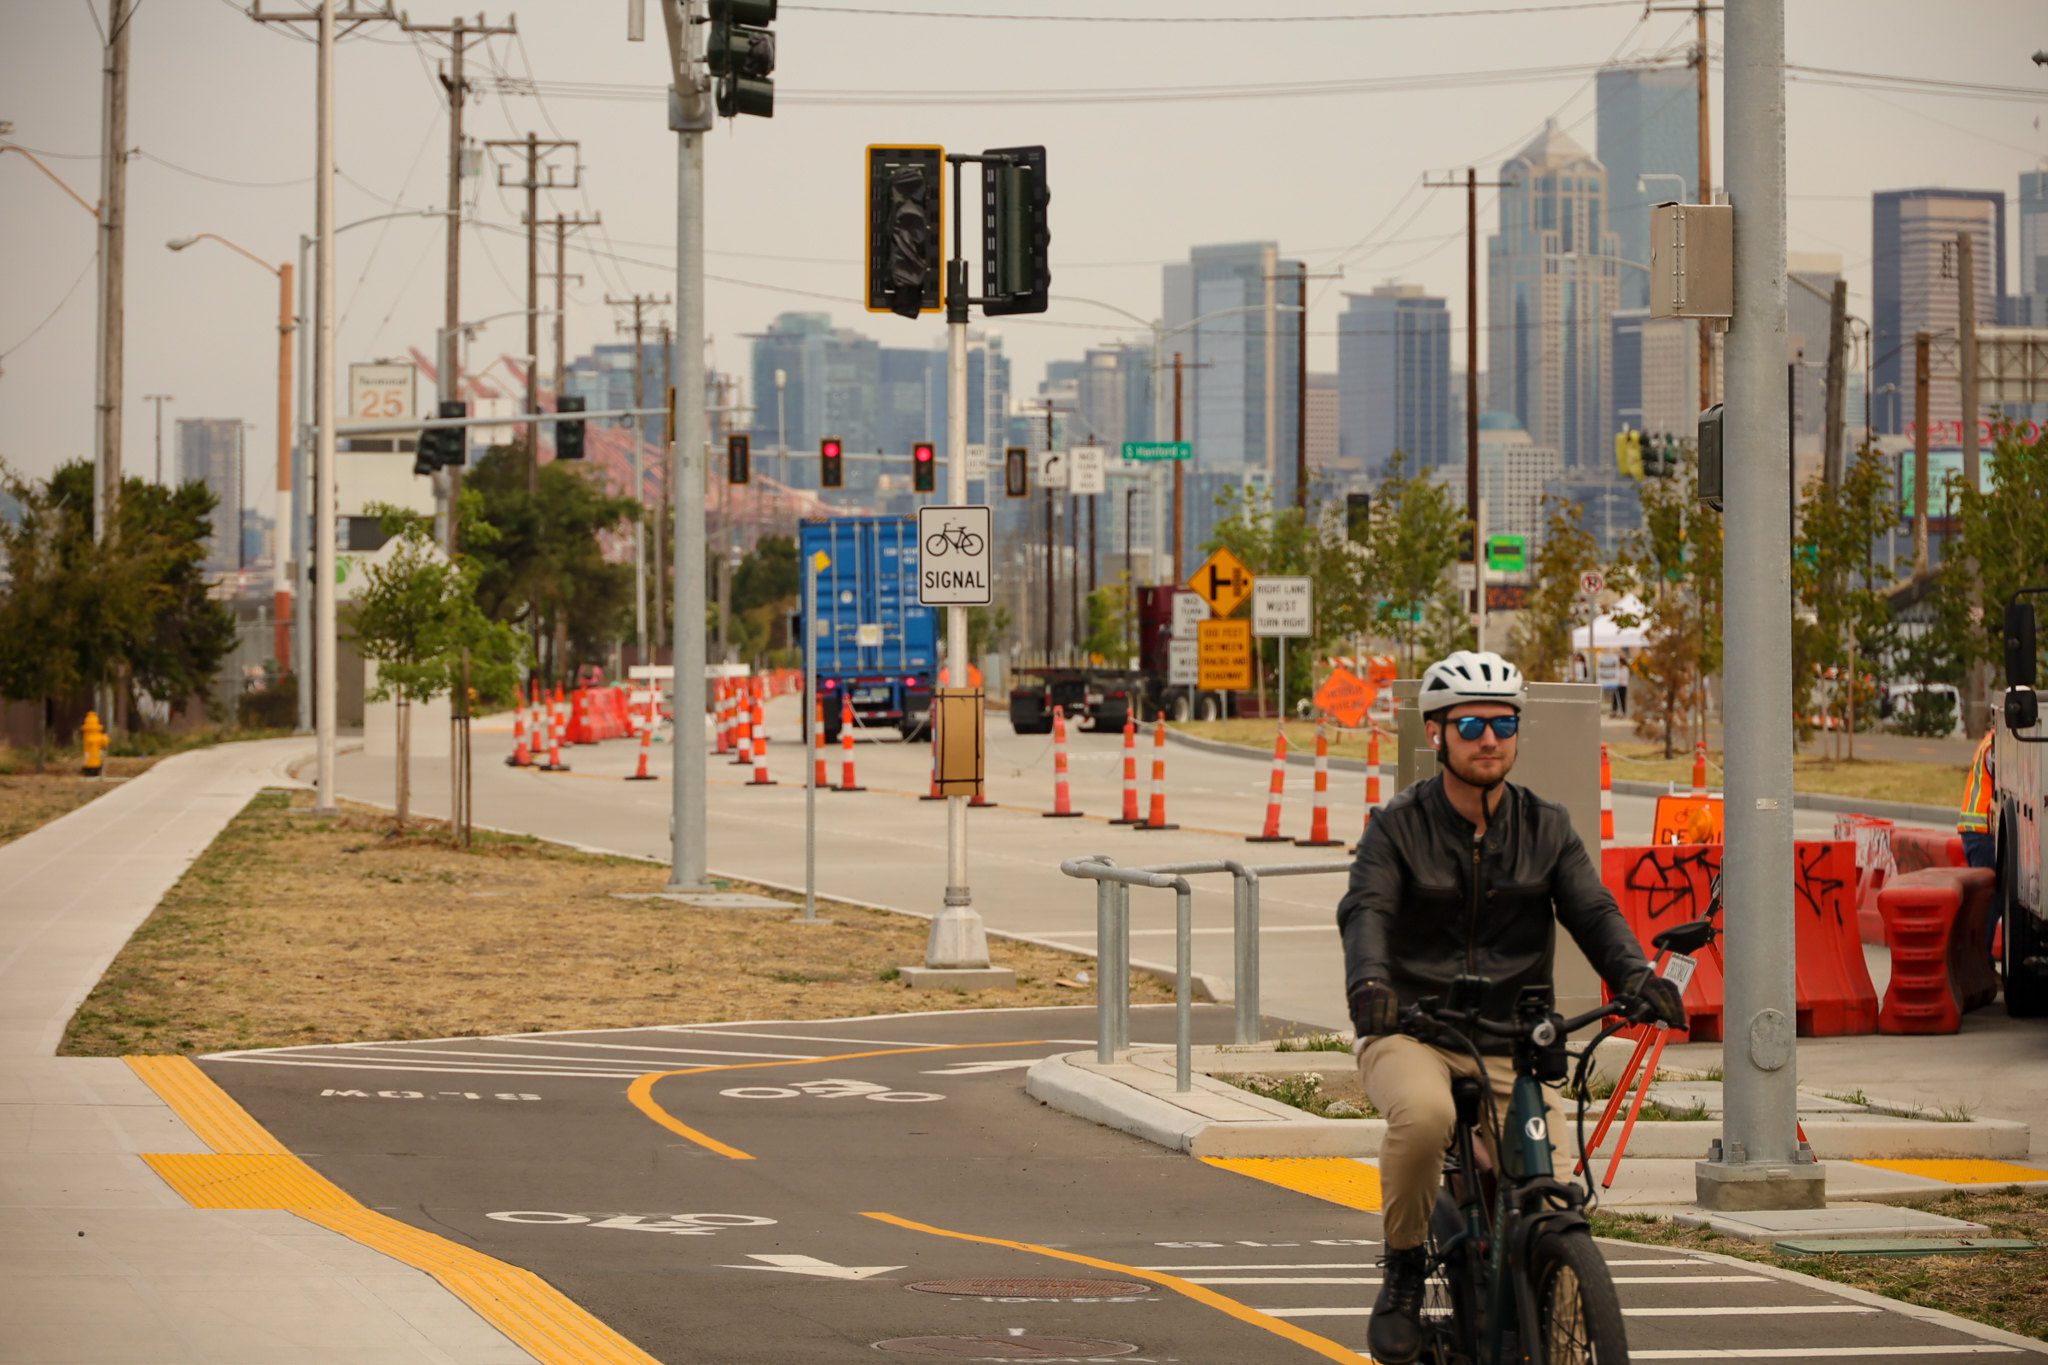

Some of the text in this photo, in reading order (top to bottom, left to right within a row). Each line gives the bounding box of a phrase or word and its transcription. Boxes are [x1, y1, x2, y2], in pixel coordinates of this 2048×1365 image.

[359, 376, 408, 385] Terminal
[360, 388, 406, 418] 25
[1125, 444, 1134, 458] S
[925, 571, 985, 589] SIGNAL
[1258, 584, 1306, 594] RIGHT LANE
[1266, 600, 1296, 612] MUST
[1258, 617, 1305, 628] TURN RIGHT
